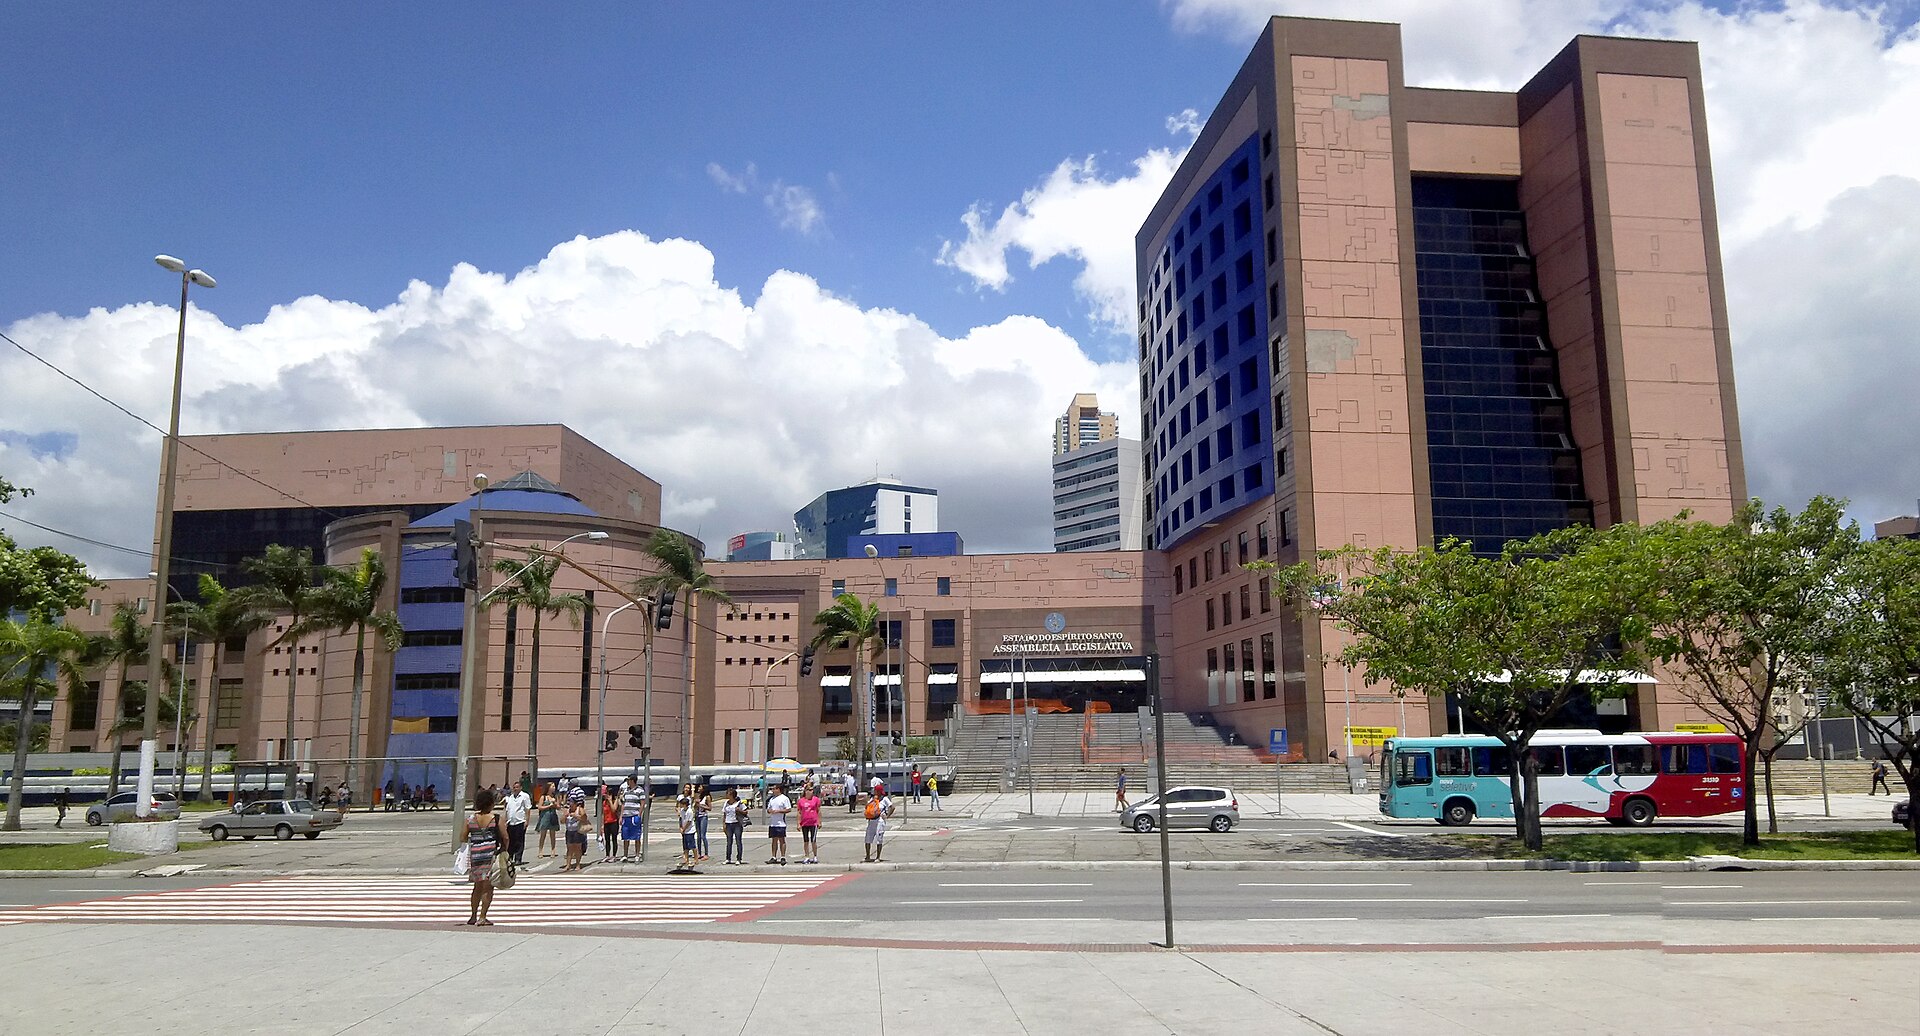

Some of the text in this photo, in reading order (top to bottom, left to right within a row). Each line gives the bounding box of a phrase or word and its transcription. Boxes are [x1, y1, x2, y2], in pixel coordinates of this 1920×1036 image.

[1051, 632, 1092, 640] ESPÍRITO
[993, 642, 1133, 653] ASSEMBLEIA LEGISLATIVA
